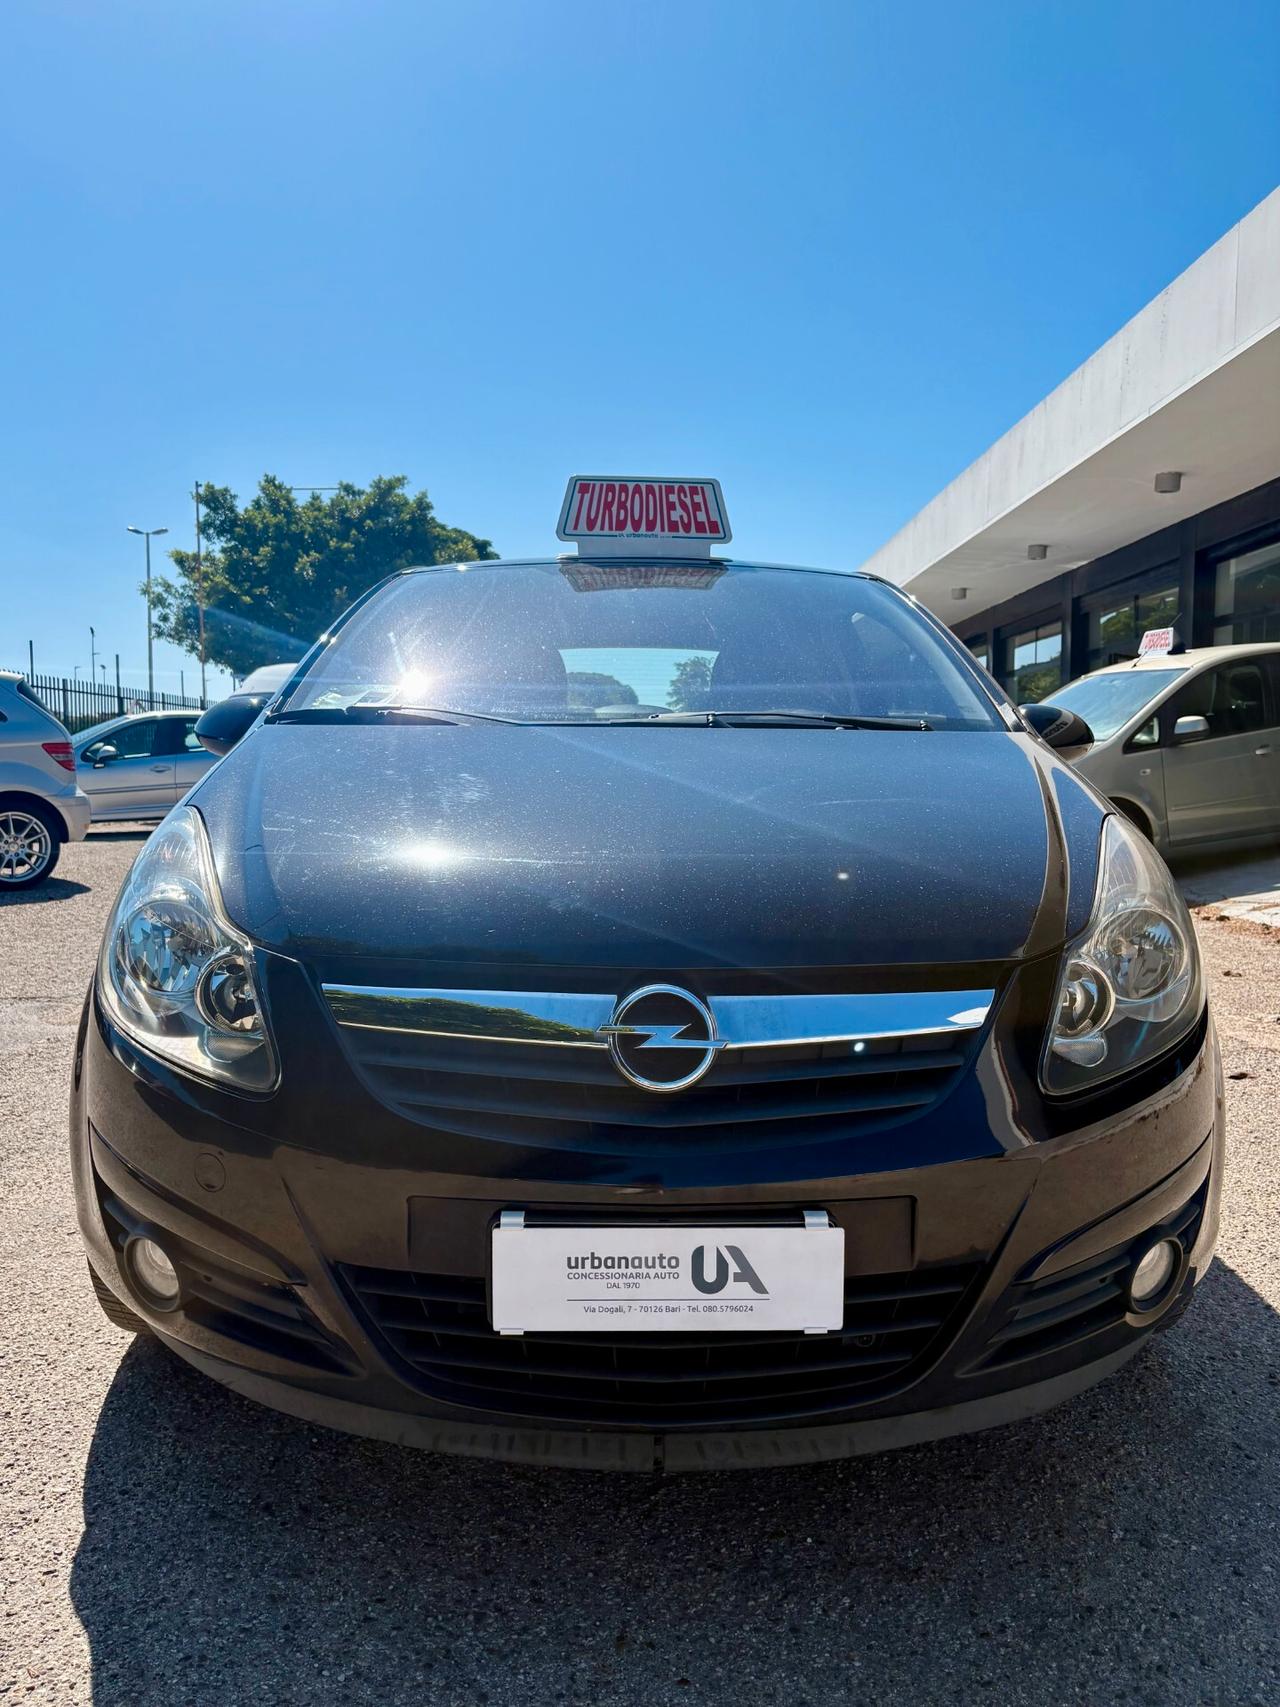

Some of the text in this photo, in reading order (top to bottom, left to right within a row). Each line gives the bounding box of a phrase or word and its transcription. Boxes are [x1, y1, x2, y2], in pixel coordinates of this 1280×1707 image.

[572, 482, 721, 534] TURBODIESEL
[566, 1252, 680, 1270] urbanauto
[691, 1245, 770, 1295] UA
[566, 1272, 680, 1280] CONCESSIONARIA AUTO
[583, 1305, 596, 1313] Via
[598, 1305, 626, 1314] Dogali,
[627, 1305, 632, 1313] 7
[639, 1305, 663, 1313] 70126
[665, 1305, 681, 1313] Bari
[687, 1305, 702, 1313] Tel.
[702, 1305, 754, 1313] 080.5796024
